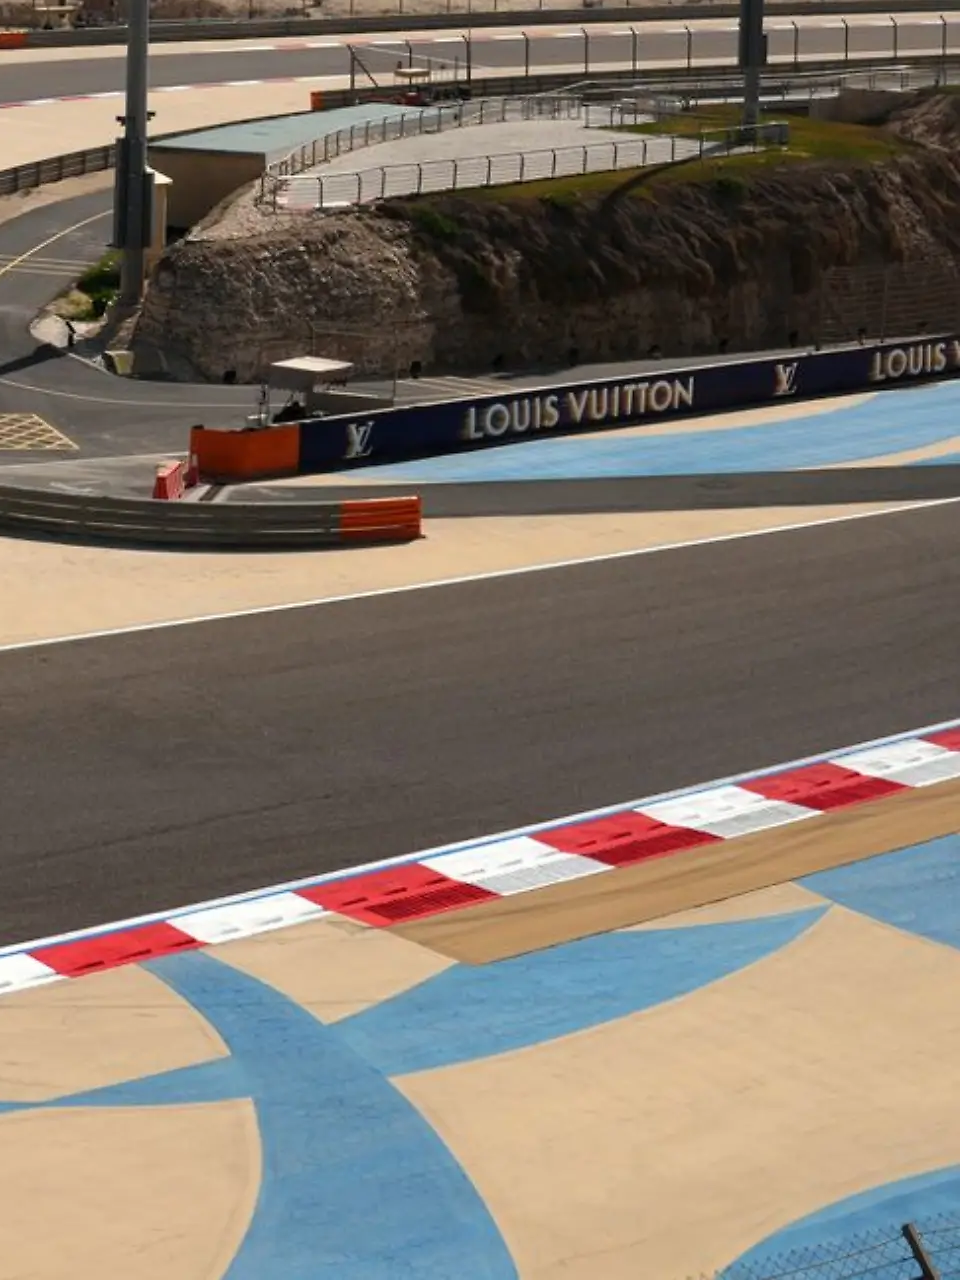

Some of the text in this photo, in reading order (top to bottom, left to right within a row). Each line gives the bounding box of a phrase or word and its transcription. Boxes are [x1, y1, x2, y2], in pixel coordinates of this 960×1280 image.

[873, 342, 947, 381] LOUIS
[468, 376, 695, 439] LOUIS VUITTON
